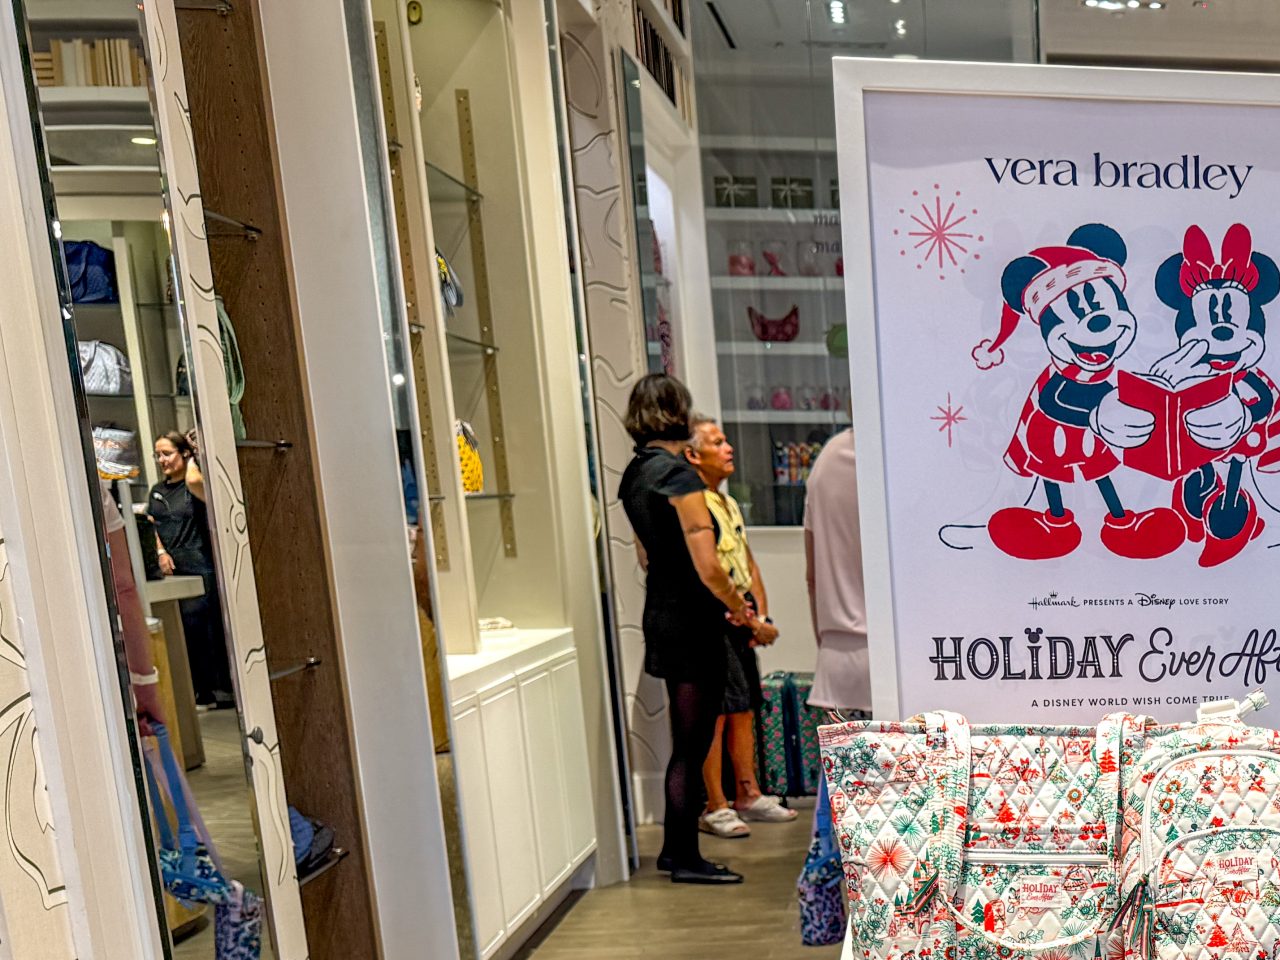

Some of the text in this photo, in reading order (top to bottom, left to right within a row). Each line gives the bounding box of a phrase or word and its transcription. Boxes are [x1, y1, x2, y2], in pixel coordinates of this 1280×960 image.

[984, 152, 1254, 199] vera bradley
[1027, 593, 1081, 610] Hallmark
[1138, 626, 1216, 683] Ever
[1043, 699, 1085, 707] DISNEY
[1089, 698, 1128, 706] WORLD
[1132, 697, 1161, 705] WISH
[1165, 696, 1198, 704] COME
[1218, 856, 1255, 869] HOLIDAY
[1021, 882, 1059, 894] HOLIDAY
